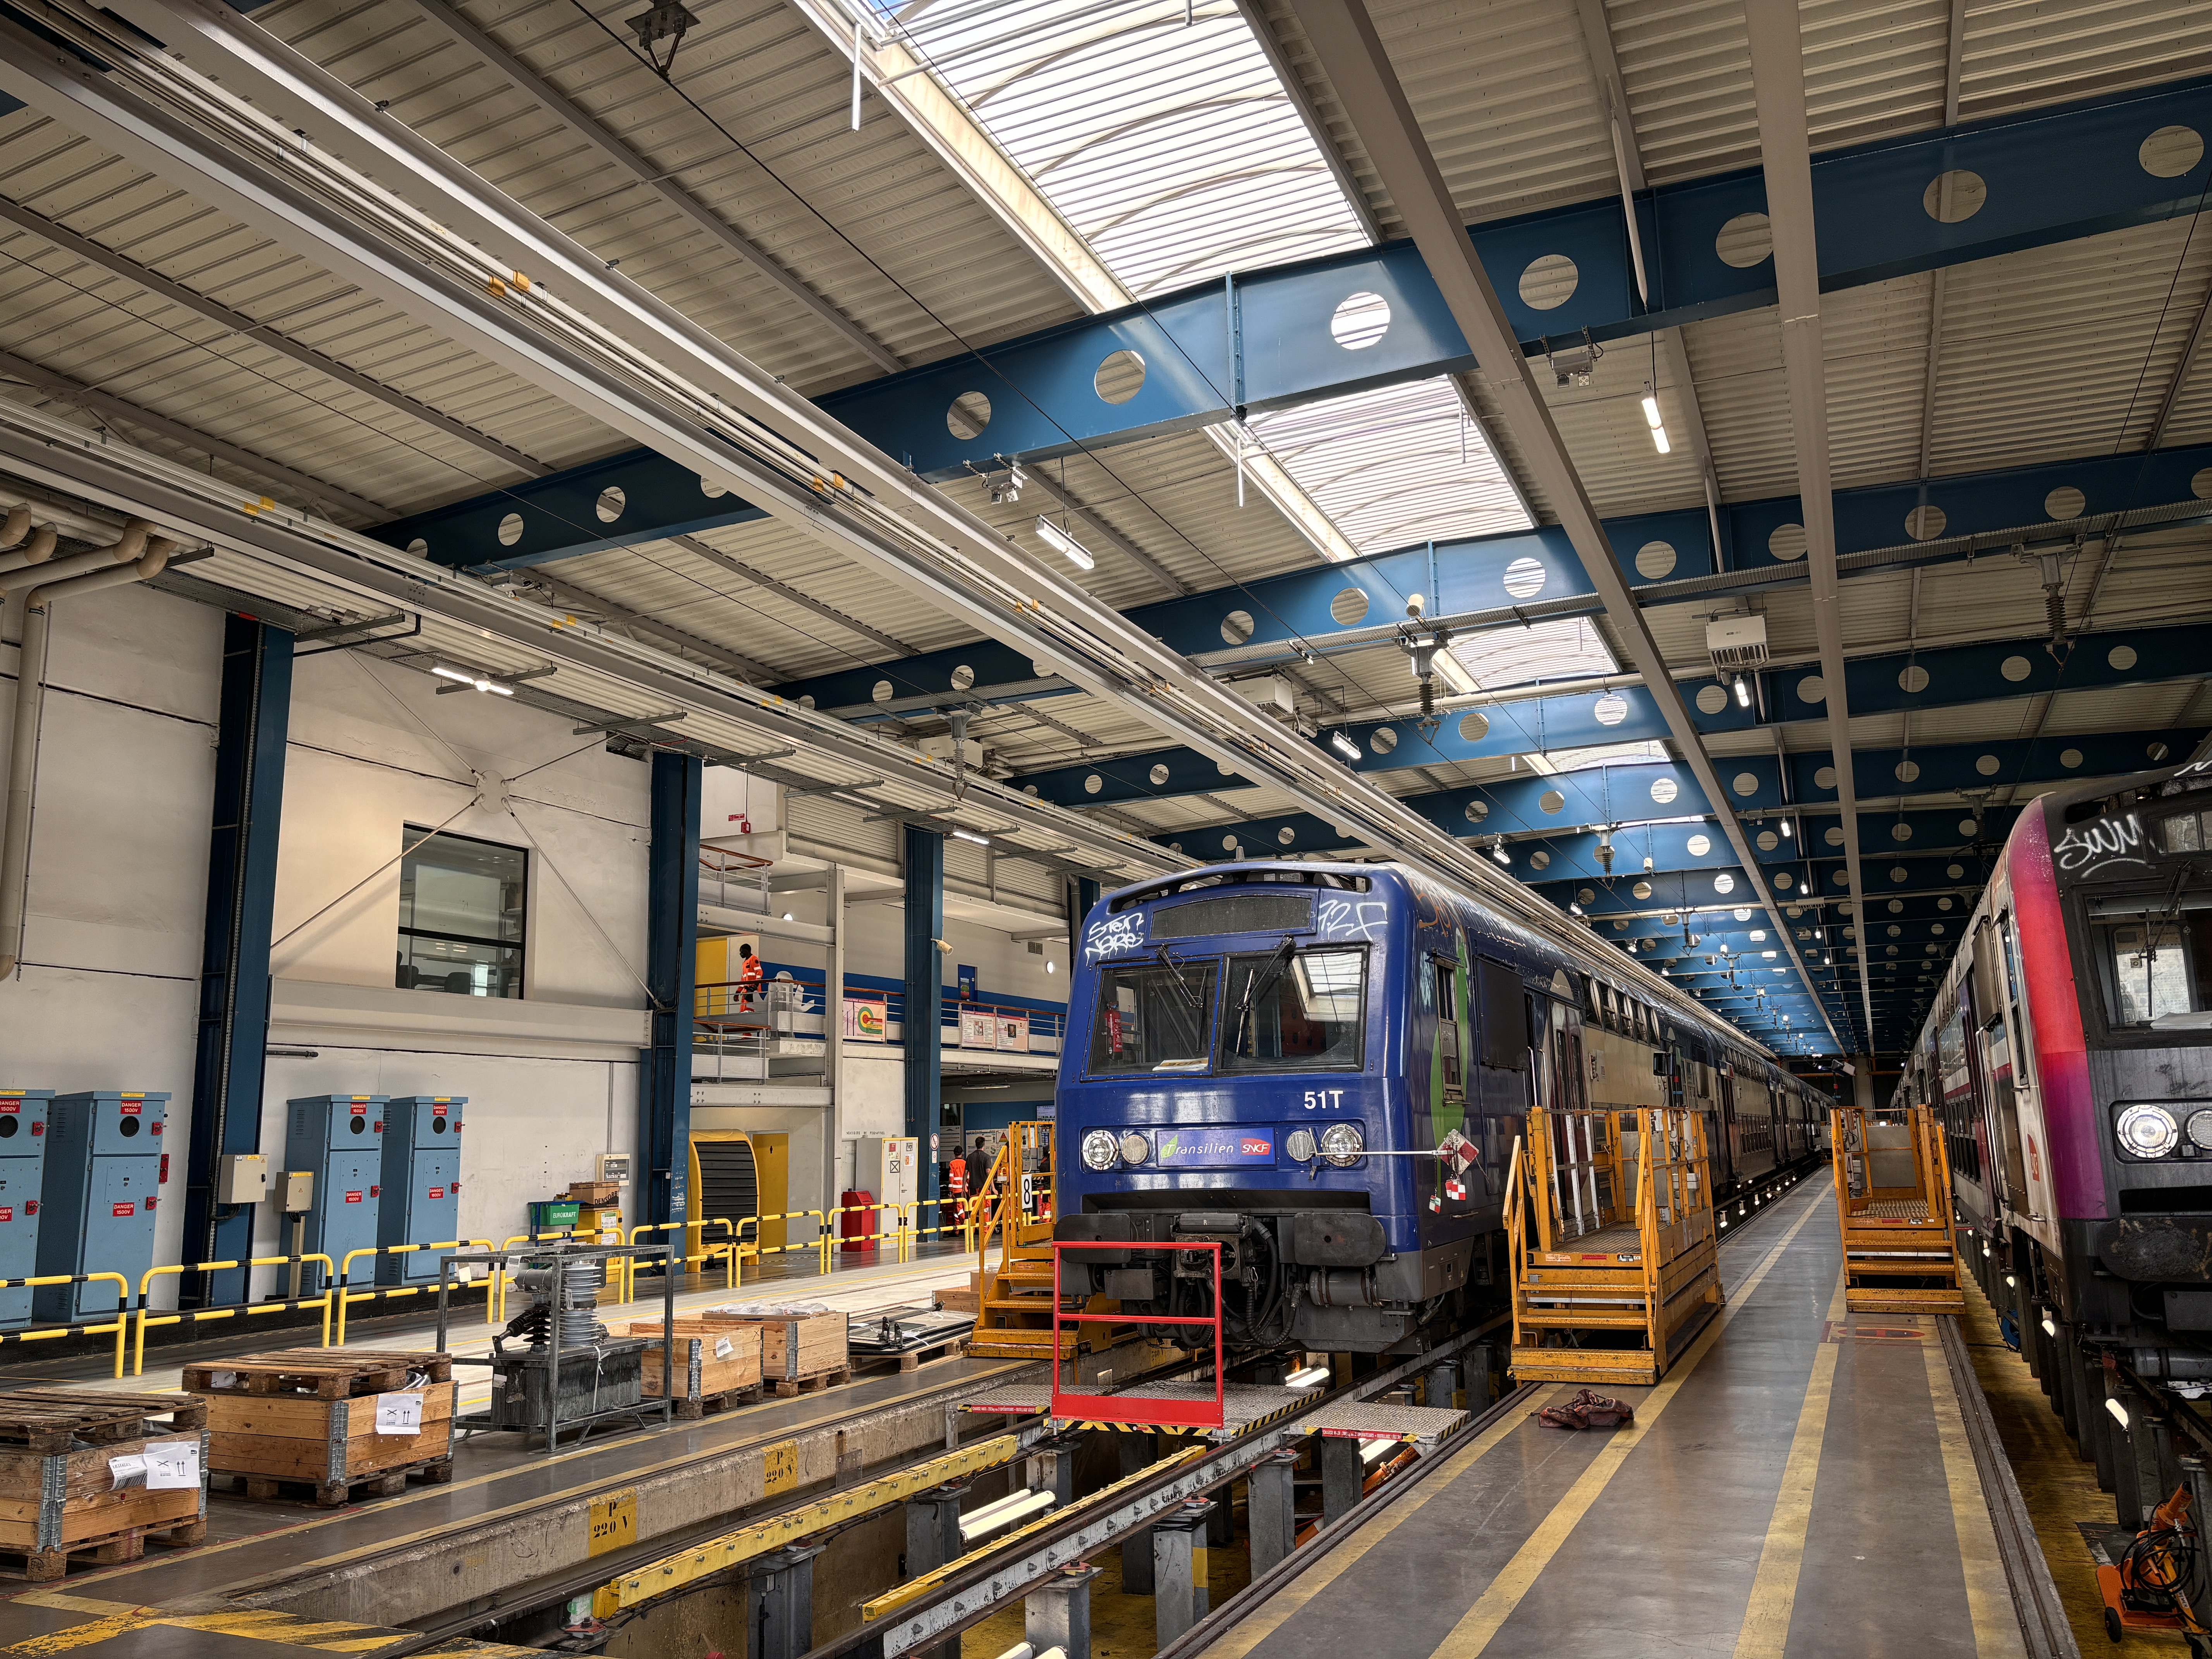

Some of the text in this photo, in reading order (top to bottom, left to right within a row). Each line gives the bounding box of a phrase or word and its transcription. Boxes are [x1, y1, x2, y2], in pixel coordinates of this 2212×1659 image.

[1304, 1090, 1343, 1109] 51T
[1166, 1142, 1233, 1154] Transilien
[1242, 1143, 1270, 1154] SNCF
[1847, 1156, 1853, 1179] 4
[594, 1190, 617, 1205] DENSORB
[1024, 1178, 1030, 1205] 8
[777, 1451, 783, 1464] P
[765, 1467, 784, 1484] 220
[609, 1502, 617, 1517] P
[593, 1513, 630, 1538] 220 V
